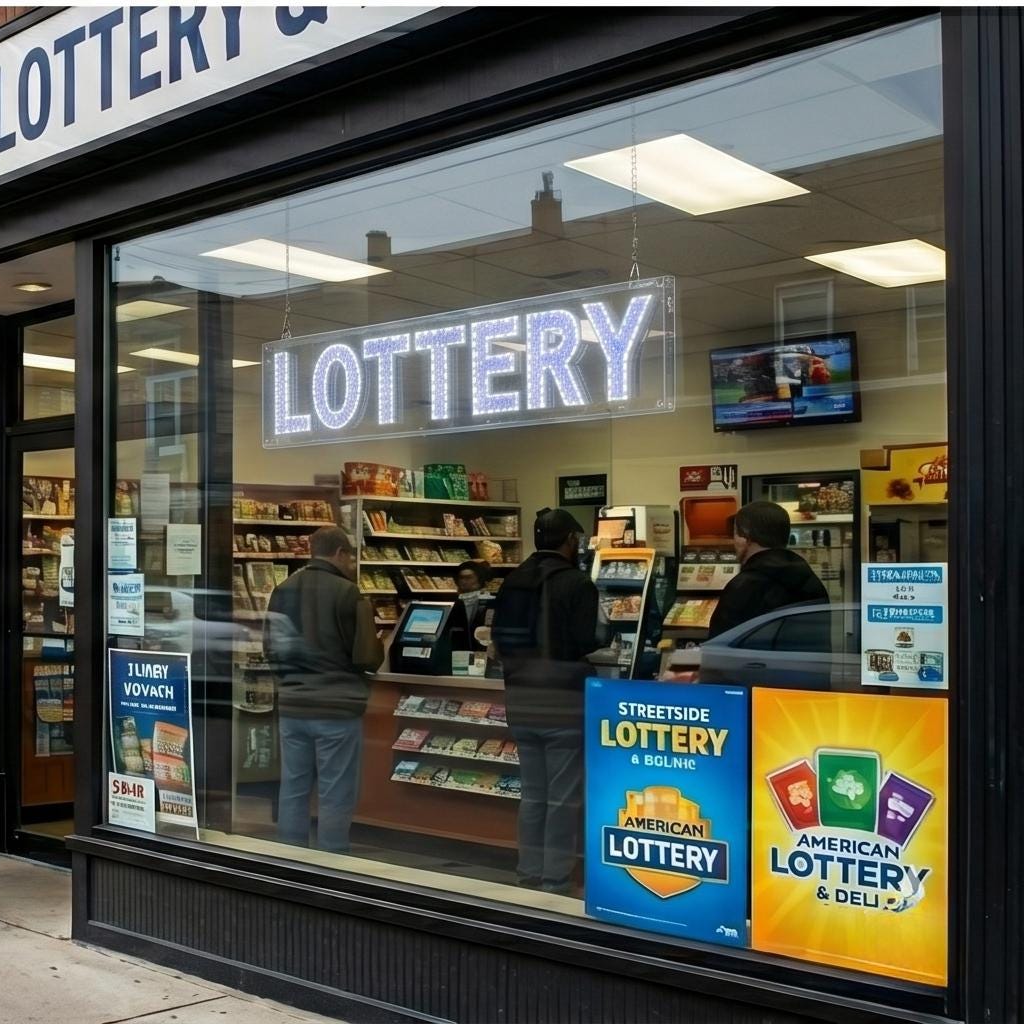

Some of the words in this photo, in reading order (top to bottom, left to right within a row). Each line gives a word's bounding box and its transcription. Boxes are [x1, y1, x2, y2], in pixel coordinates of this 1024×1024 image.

[273, 294, 654, 435] LOTTERY
[618, 701, 710, 722] STREETSIDE
[601, 719, 729, 757] LOTTERY
[624, 816, 704, 838] AMERICAN
[609, 834, 719, 873] LOTTERY
[796, 833, 900, 860] AMERICAN
[771, 847, 930, 895] LOTTERY
[816, 885, 830, 901] &
[835, 888, 879, 909] DELI
